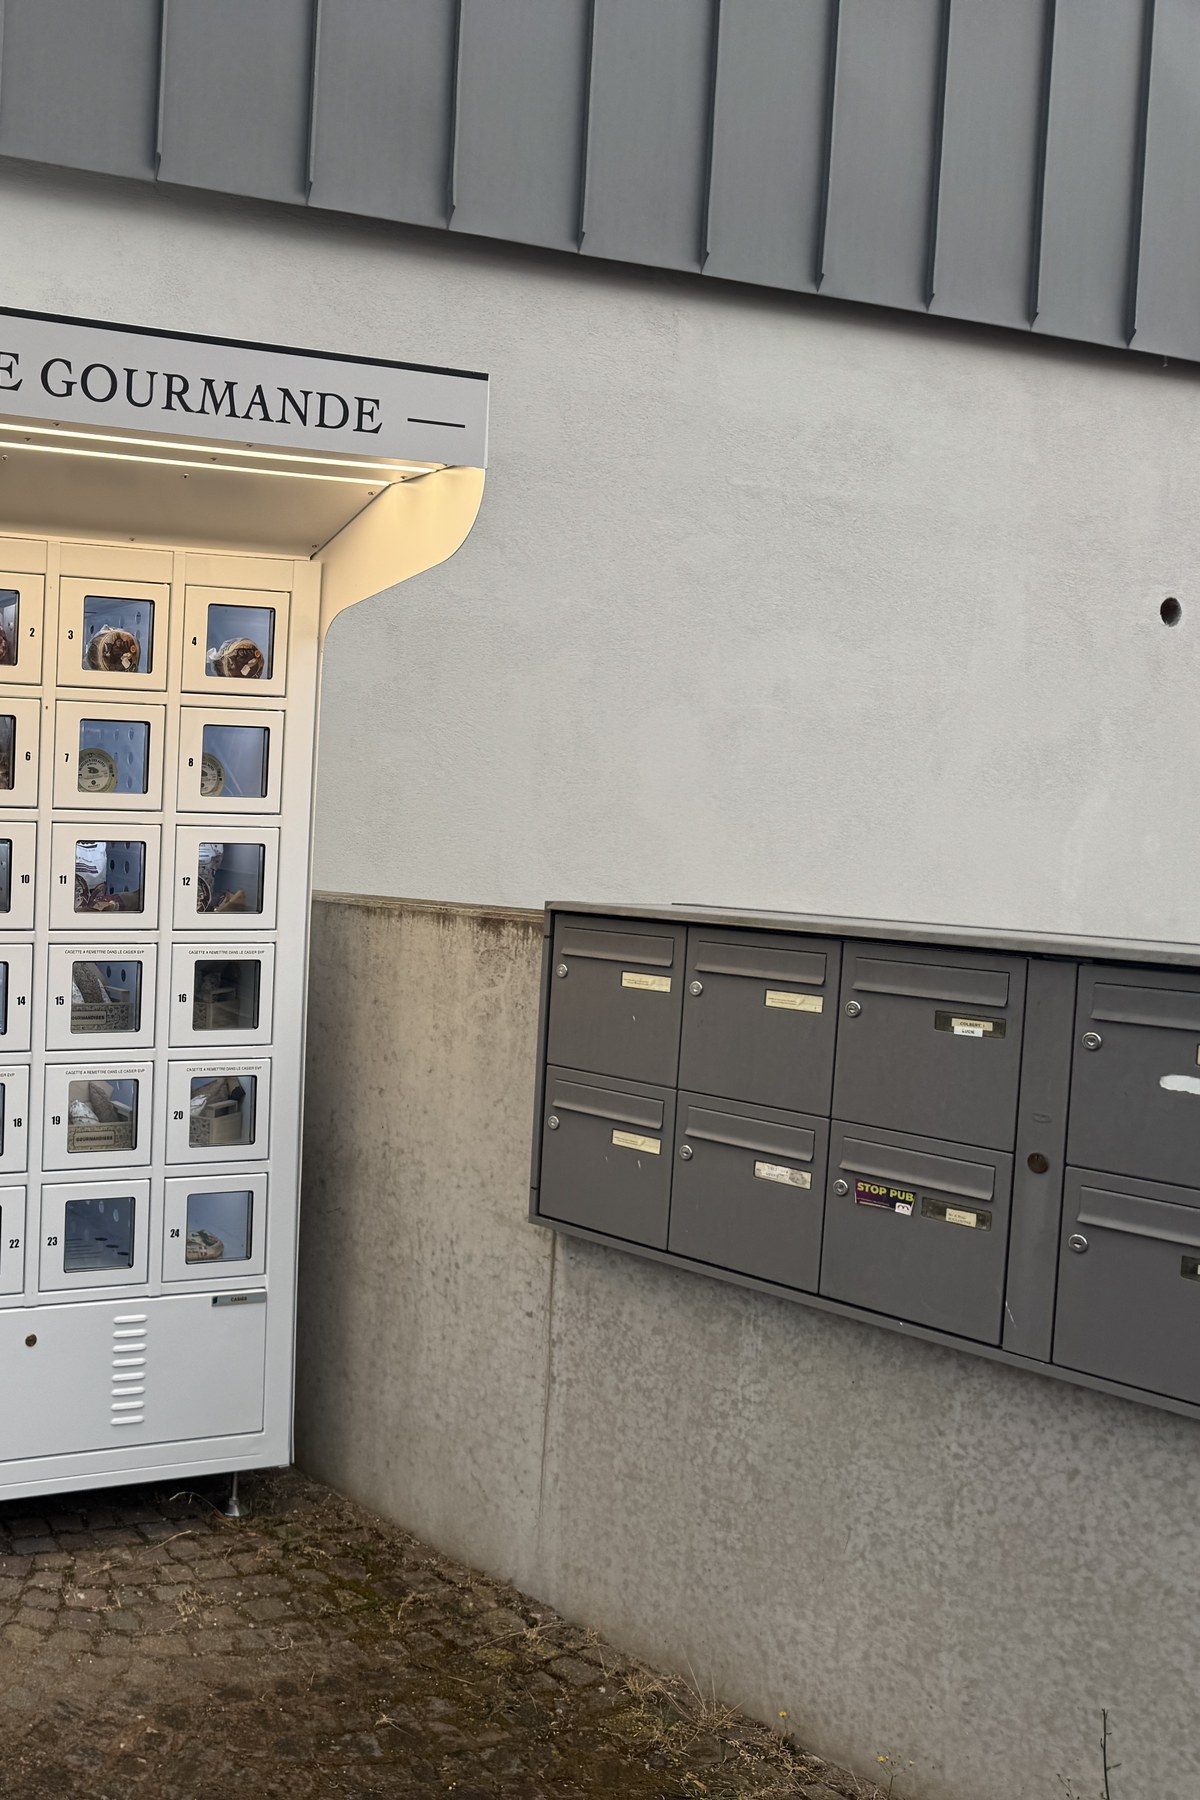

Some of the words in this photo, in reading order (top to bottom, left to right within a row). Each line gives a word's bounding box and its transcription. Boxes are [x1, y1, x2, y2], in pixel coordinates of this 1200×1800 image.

[40, 358, 384, 434] GOURMANDE
[29, 628, 36, 638] 2
[68, 630, 74, 640] 3
[191, 637, 197, 646] 4
[25, 752, 31, 762] 6
[64, 753, 70, 763] 7
[188, 757, 194, 767] 8
[20, 874, 30, 884] 10
[59, 875, 67, 885] 11
[182, 877, 191, 886] 12
[16, 996, 26, 1006] 14
[55, 996, 65, 1006] 15
[178, 993, 187, 1003] 16
[173, 1110, 184, 1120] 20
[12, 1118, 22, 1128] 18
[51, 1115, 61, 1126] 19
[857, 1182, 887, 1195] STOP
[890, 1189, 914, 1202] PUB
[170, 1228, 180, 1238] 24
[9, 1239, 20, 1249] 22
[47, 1236, 58, 1246] 23
